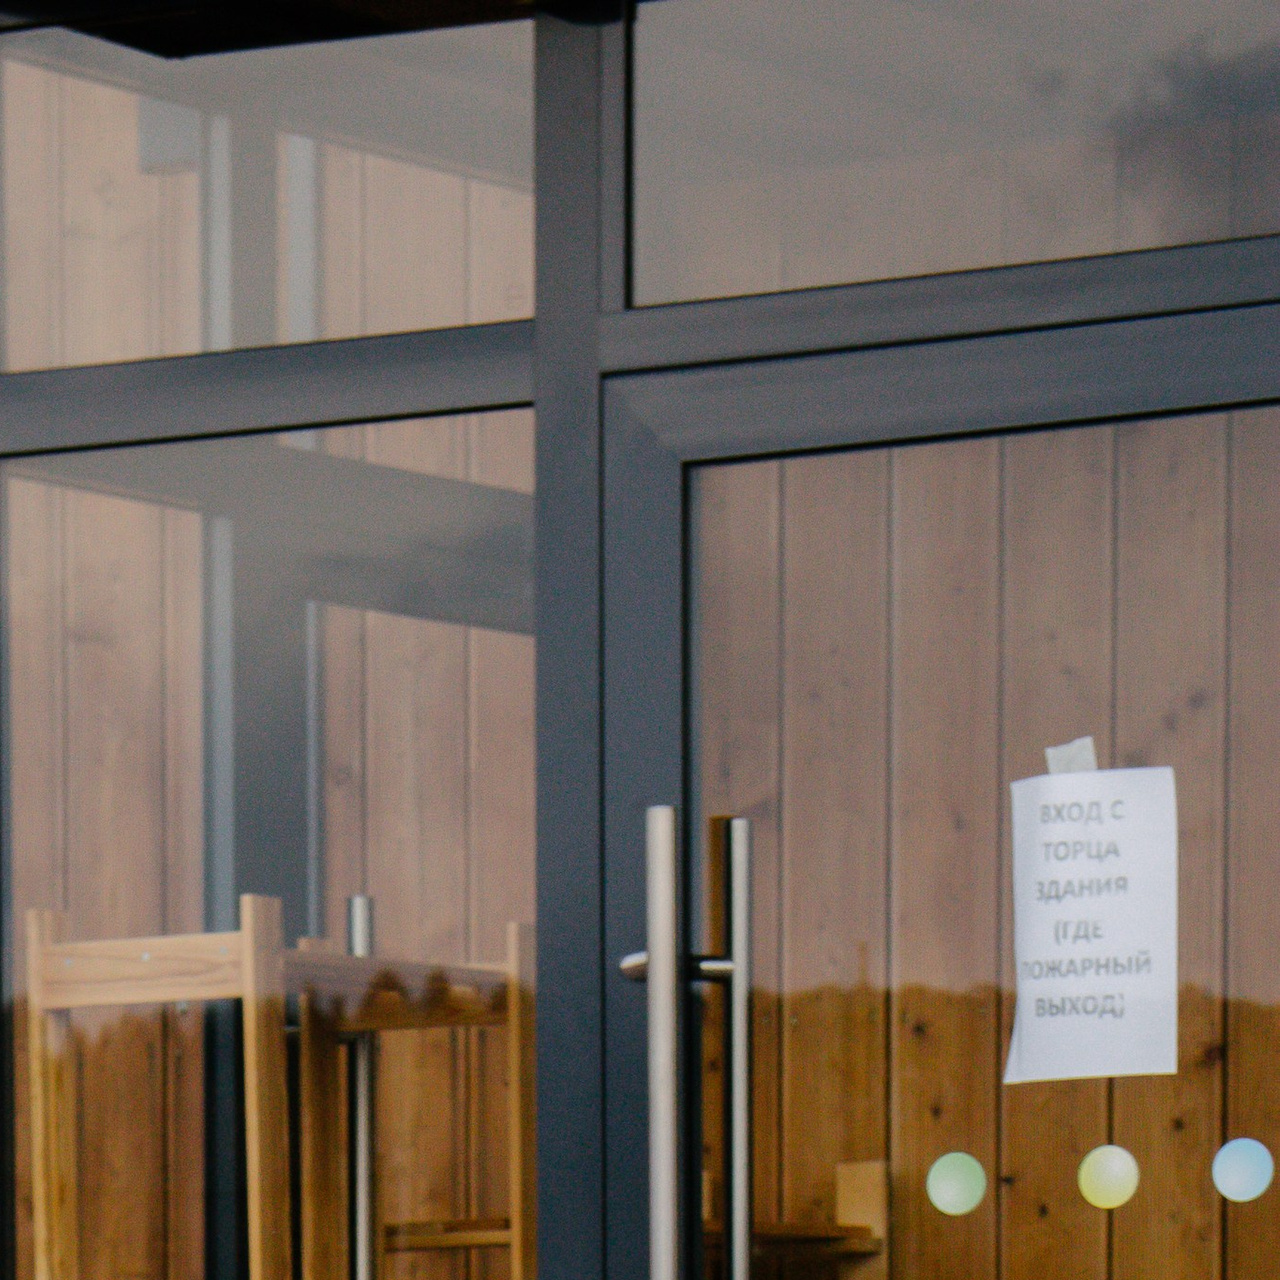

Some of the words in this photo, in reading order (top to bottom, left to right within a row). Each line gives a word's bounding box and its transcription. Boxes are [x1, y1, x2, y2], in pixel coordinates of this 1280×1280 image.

[1040, 801, 1103, 825] ВХОД
[1110, 799, 1125, 820] С
[1043, 841, 1120, 863] ТОРЦА
[1036, 876, 1129, 904] ЗДАНИЯ
[1054, 919, 1104, 945] (ГДЕ
[1035, 993, 1125, 1019] ВЫХОД)
